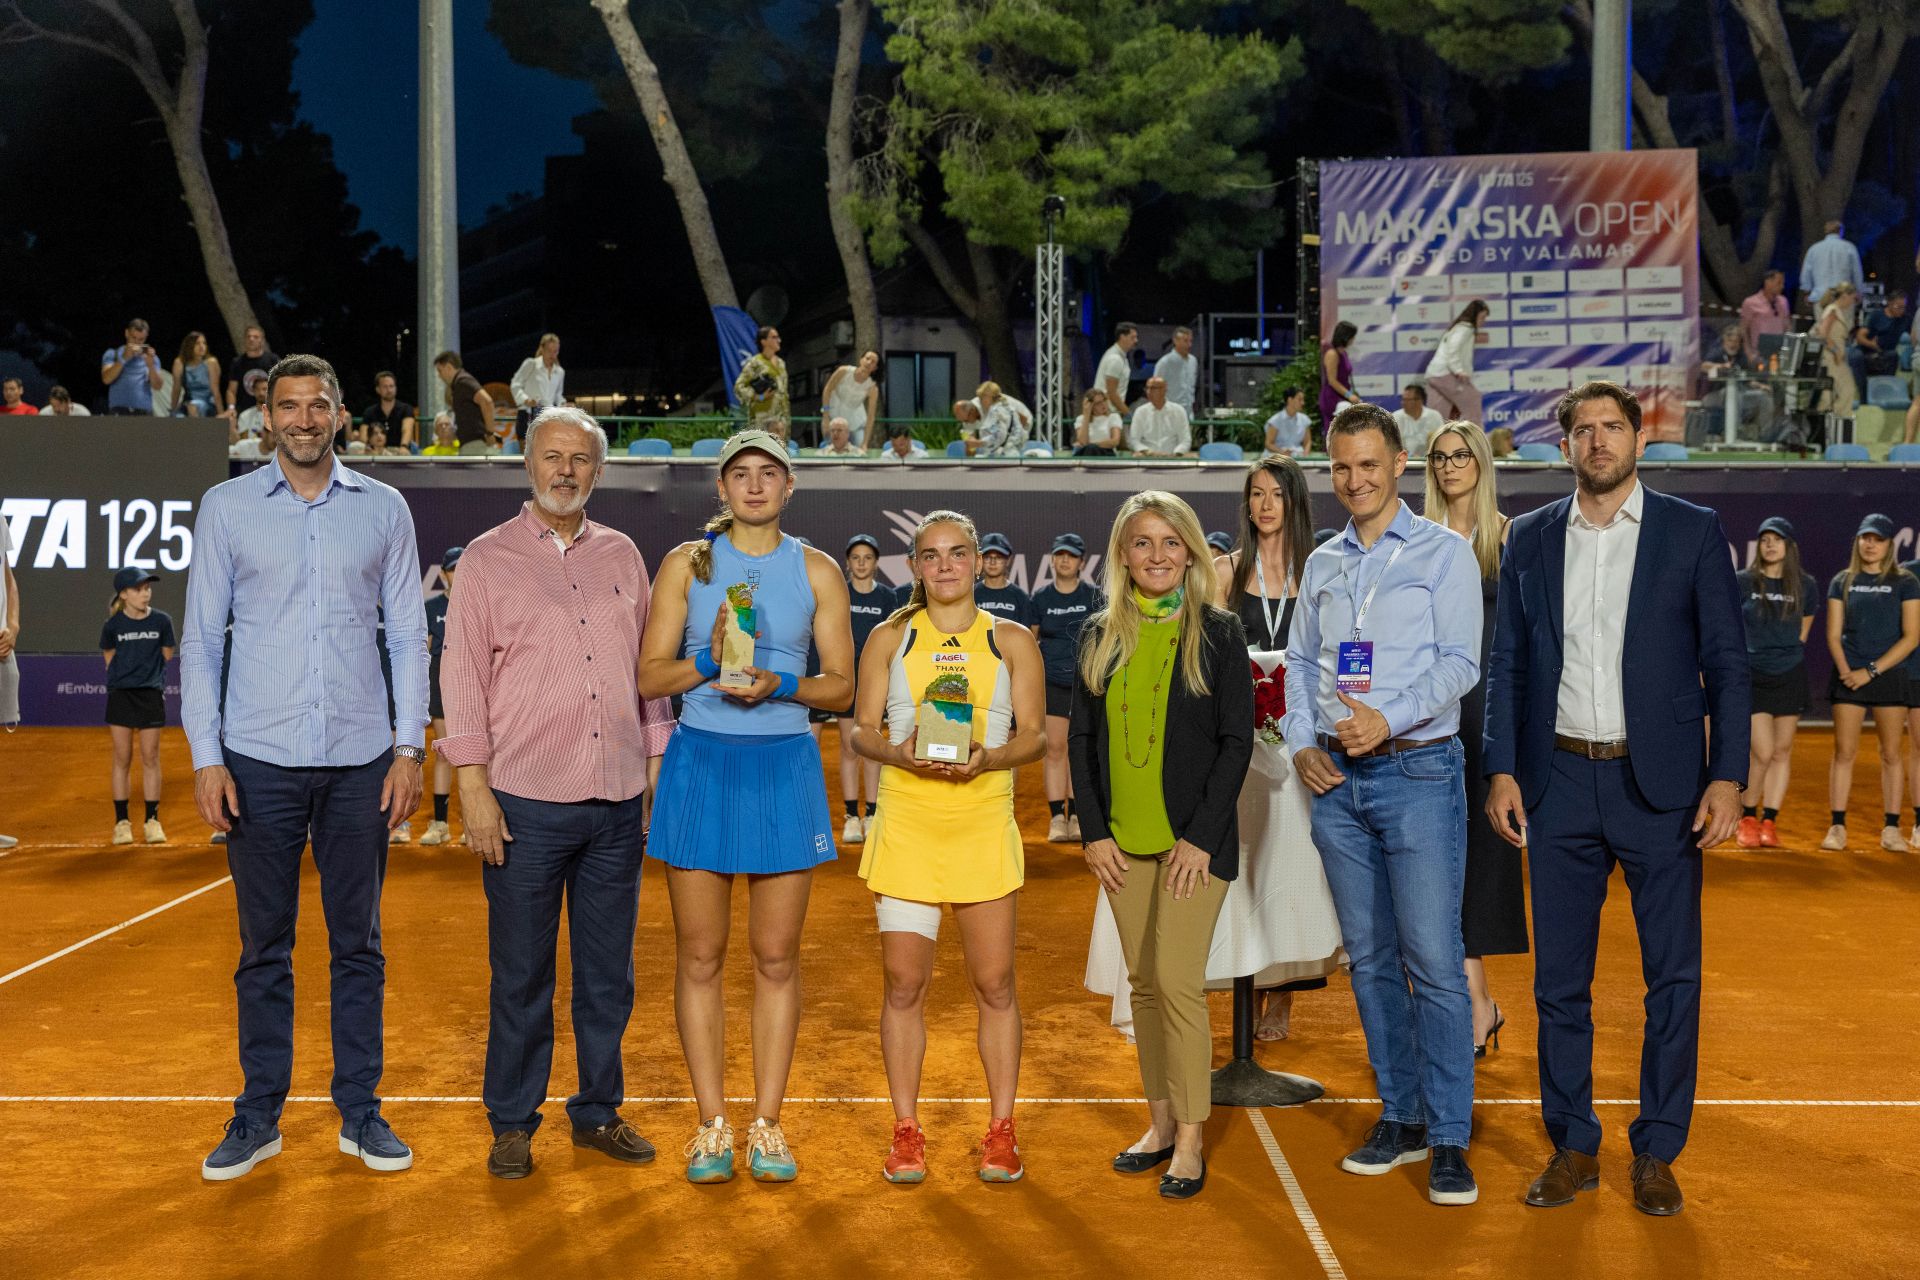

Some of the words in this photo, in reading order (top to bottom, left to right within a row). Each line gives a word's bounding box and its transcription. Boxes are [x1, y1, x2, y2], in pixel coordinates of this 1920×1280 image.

[1334, 205, 1563, 245] MAKARSKA
[1574, 201, 1680, 237] OPEN
[1379, 248, 1473, 266] HOSTED
[1484, 247, 1512, 262] BY
[1523, 243, 1636, 261] VALAMAR
[1487, 405, 1511, 421] for
[0, 498, 87, 568] TA
[100, 498, 193, 570] 125
[1848, 585, 1892, 593] HEAD
[850, 605, 881, 615] EAD
[1047, 605, 1087, 615] HEAD
[117, 631, 160, 641] HEAD
